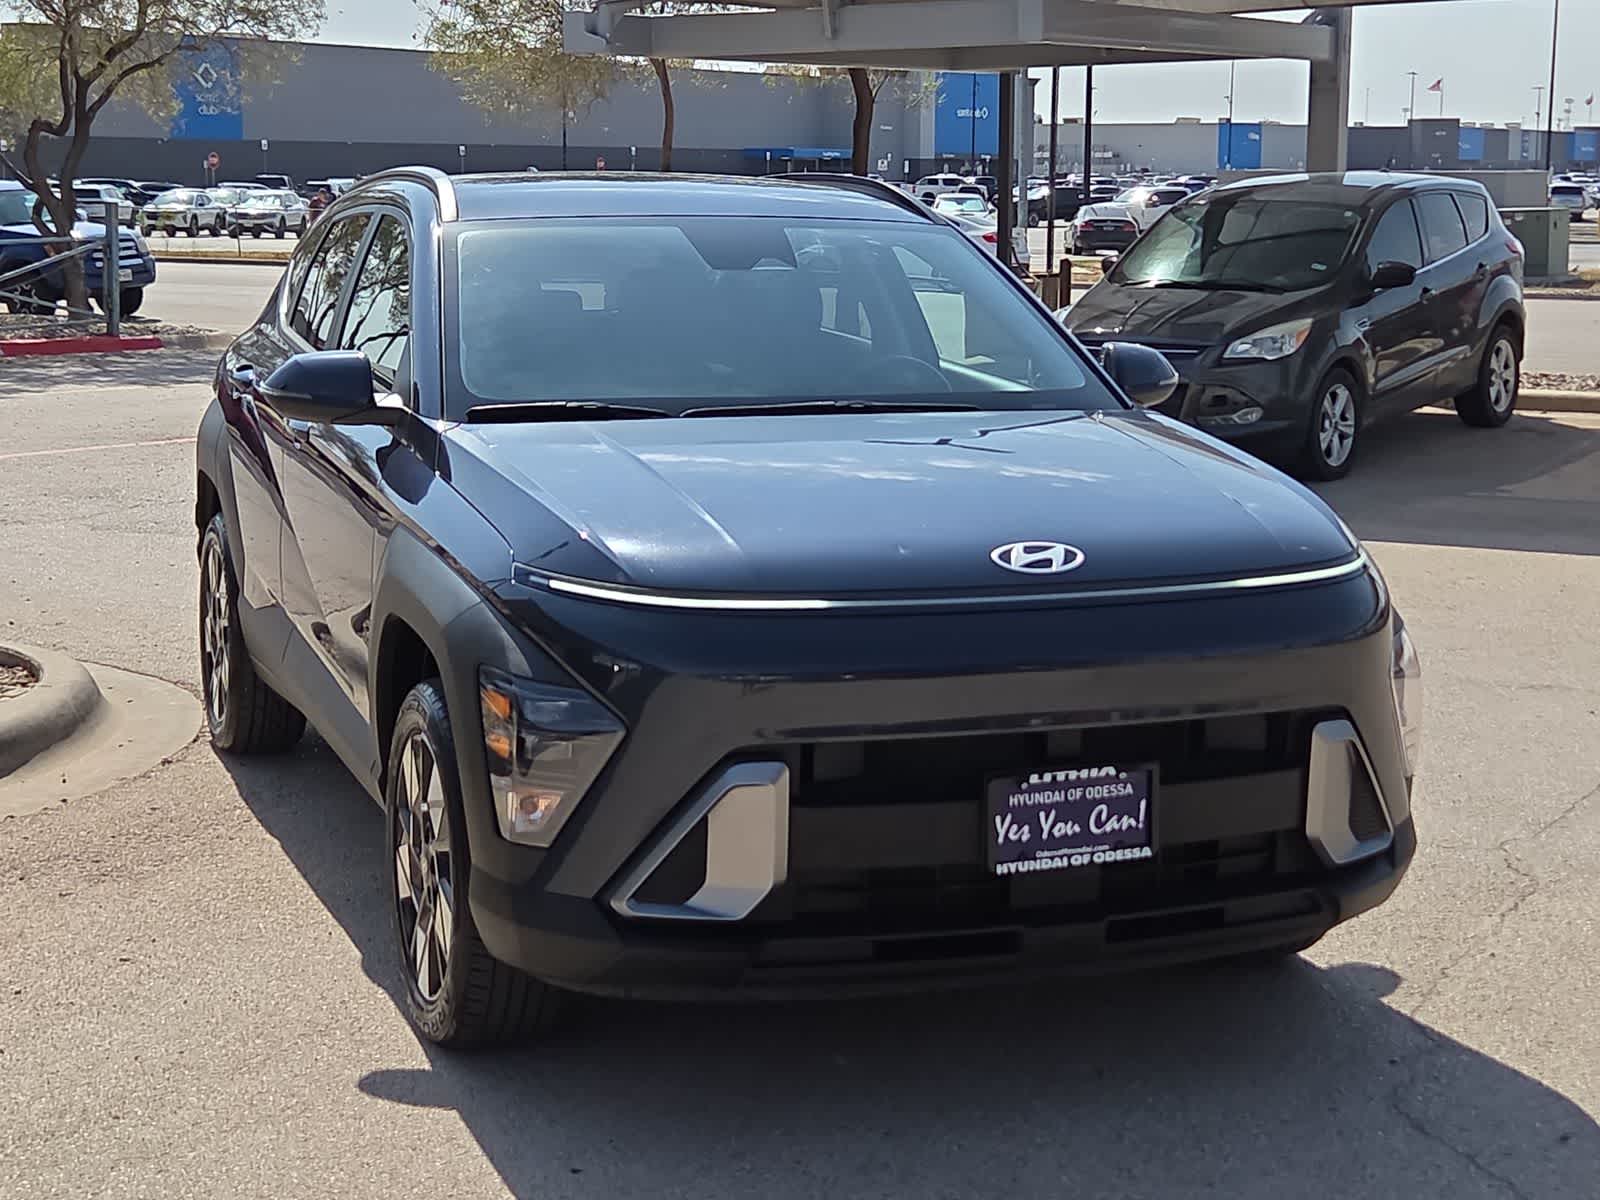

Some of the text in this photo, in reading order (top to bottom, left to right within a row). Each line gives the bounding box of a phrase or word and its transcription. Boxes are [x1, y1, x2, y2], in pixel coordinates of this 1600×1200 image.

[1009, 783, 1134, 807] HYUNDAI OF ODESSA
[994, 798, 1147, 845] Yes You Can!
[996, 846, 1152, 875] HYUNDAI OF ODESSA
